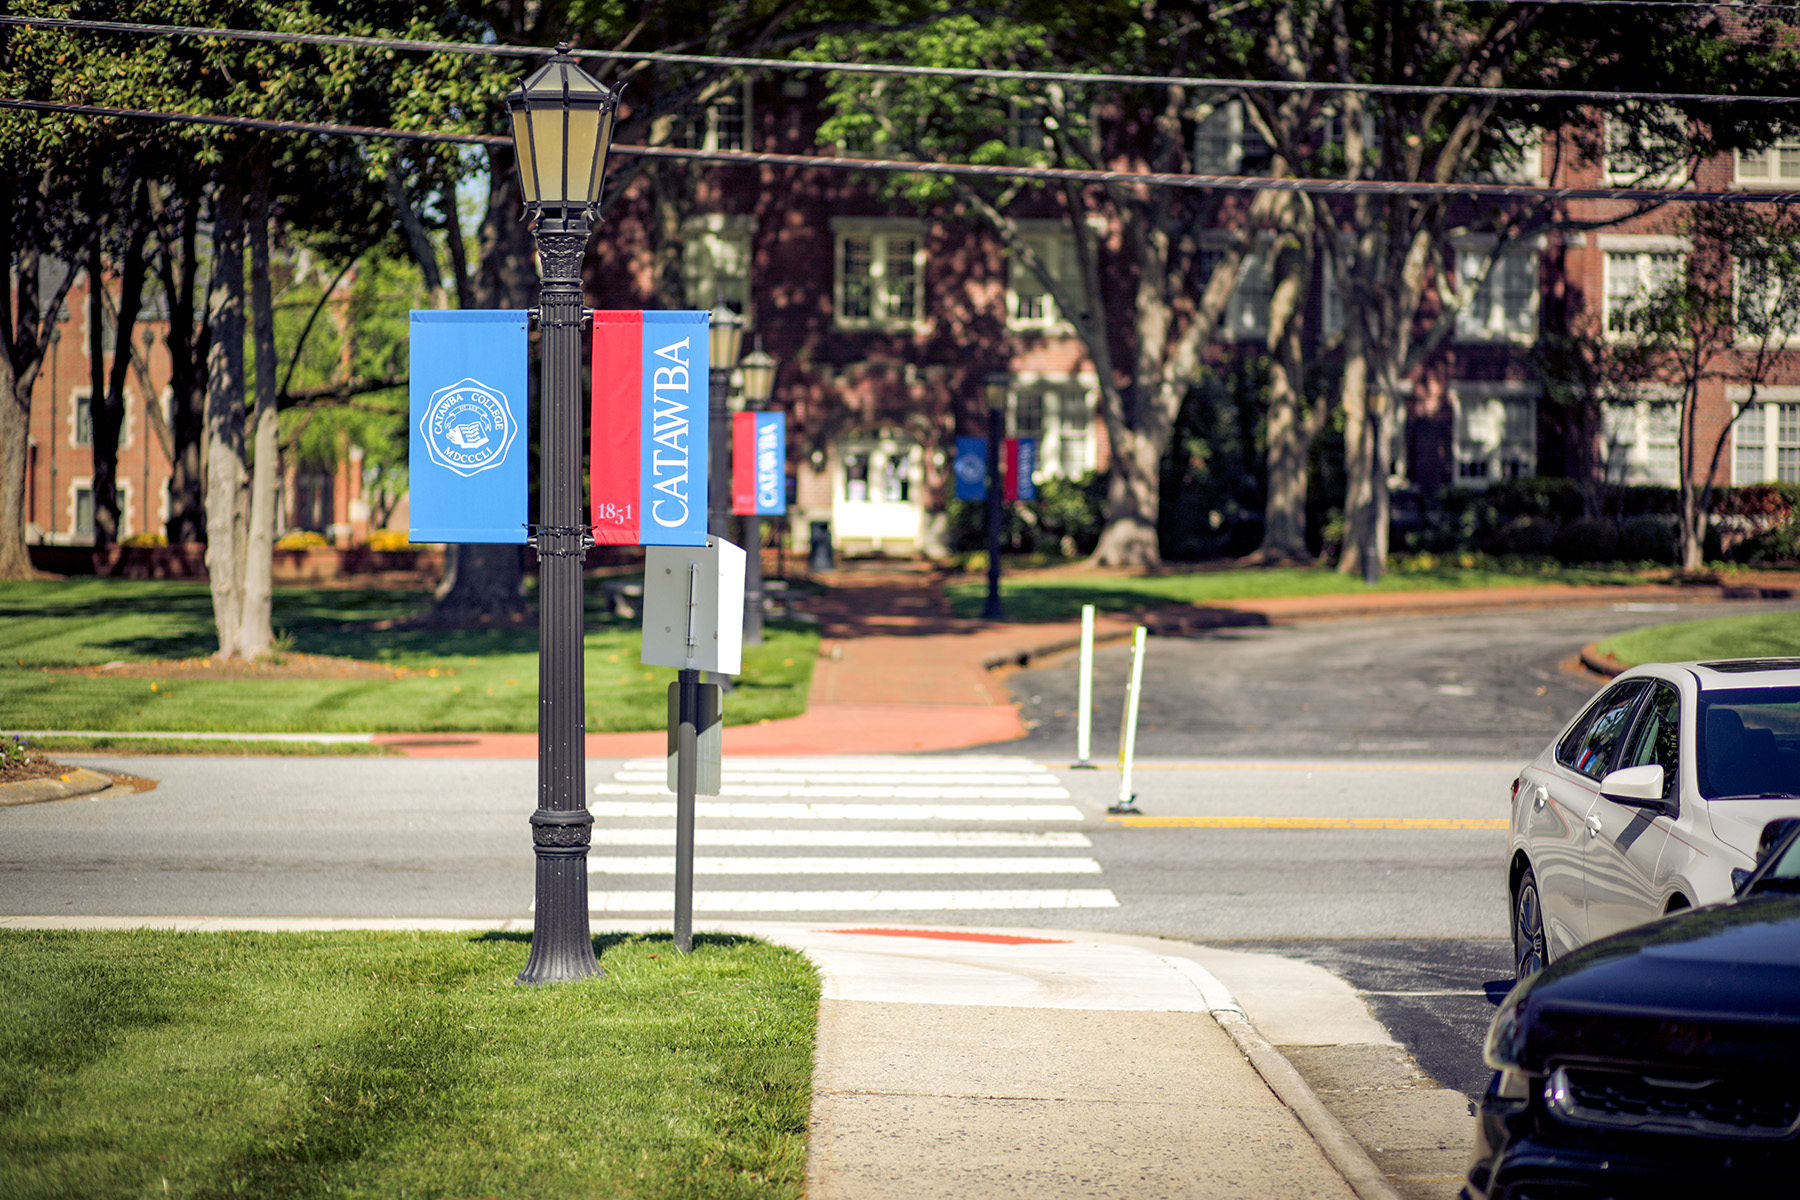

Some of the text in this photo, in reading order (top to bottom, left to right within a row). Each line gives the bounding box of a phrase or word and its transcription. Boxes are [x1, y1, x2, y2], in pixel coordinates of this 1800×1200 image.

[434, 392, 504, 435] CATAWBA COLLEGE
[652, 336, 690, 528] CATAWBA
[443, 446, 494, 464] MDCCCLI
[597, 502, 633, 525] 1851
